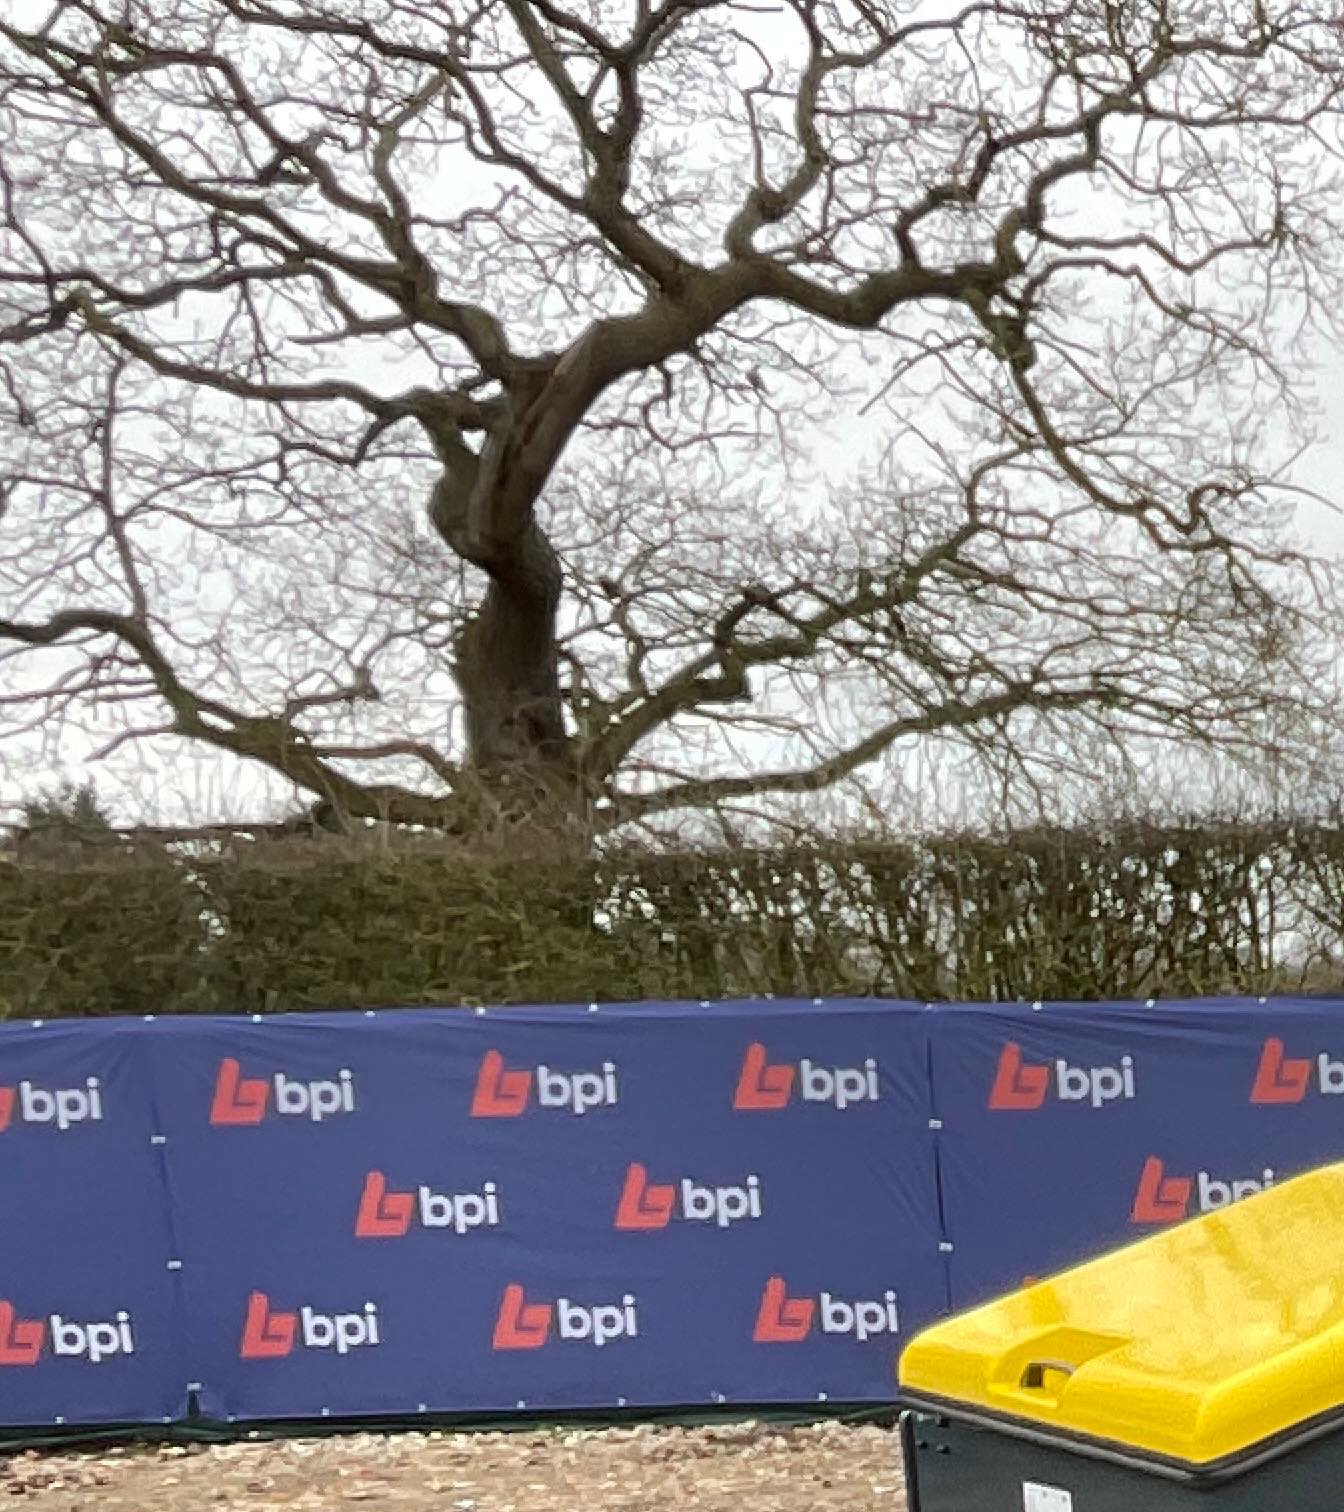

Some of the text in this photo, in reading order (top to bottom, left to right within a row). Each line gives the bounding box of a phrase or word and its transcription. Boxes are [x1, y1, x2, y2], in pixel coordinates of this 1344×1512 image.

[20, 1076, 102, 1130] bpi
[274, 1068, 354, 1122] bpi
[536, 1062, 618, 1114] bpi
[800, 1058, 880, 1110] bpi
[1056, 1055, 1134, 1108] bpi
[418, 1182, 500, 1234] bpi
[680, 1174, 762, 1228] bpi
[50, 1310, 134, 1363] bpi
[302, 1301, 380, 1354] bpi
[556, 1294, 638, 1346] bpi
[820, 1290, 899, 1342] bpi
